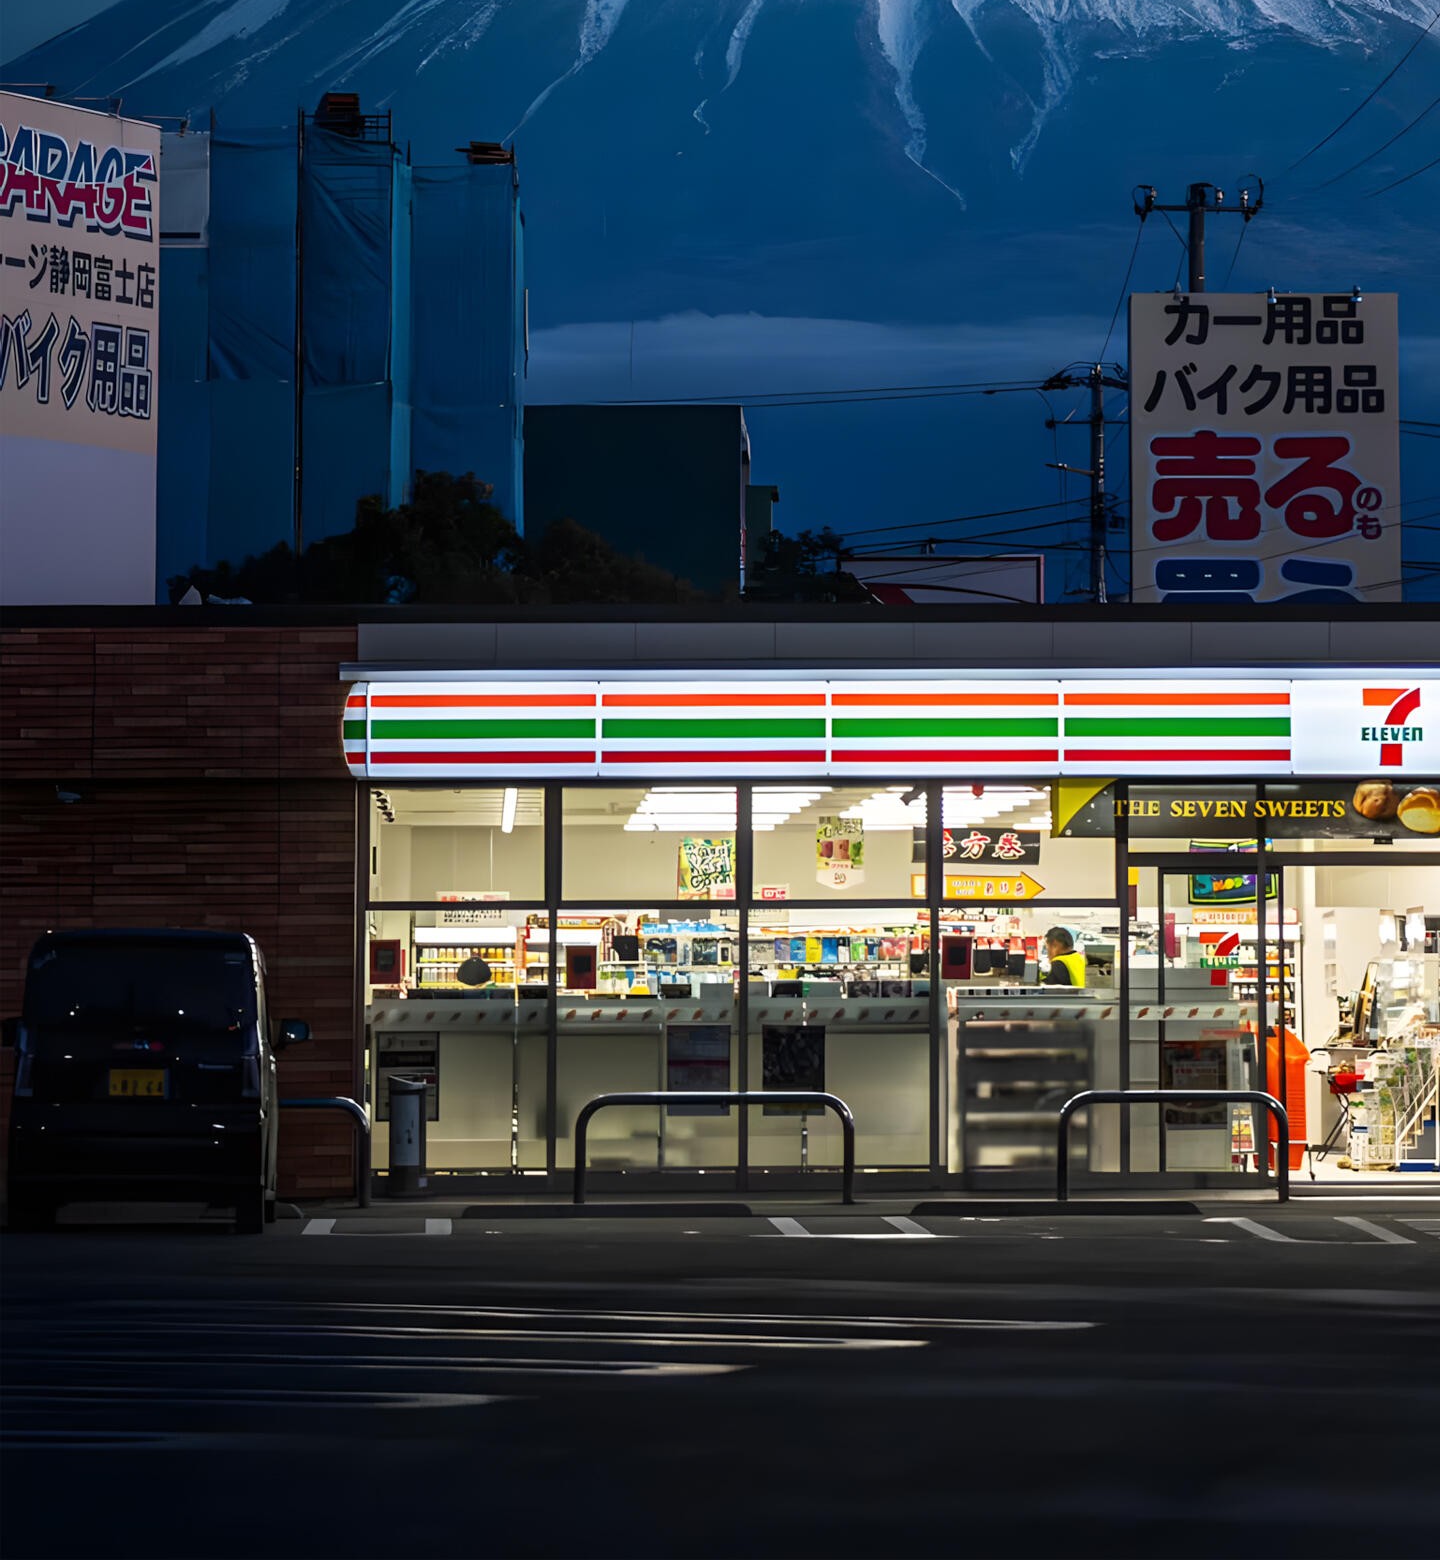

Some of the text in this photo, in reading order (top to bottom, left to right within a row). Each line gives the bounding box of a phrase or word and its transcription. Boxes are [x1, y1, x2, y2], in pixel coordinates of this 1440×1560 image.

[0, 121, 157, 242] ARAGE
[0, 244, 156, 309] ージ静岡富士店
[1164, 295, 1364, 345] カー用品
[0, 309, 152, 419] バイク用品
[1144, 362, 1385, 415] バイク用品
[1149, 430, 1362, 541] 売る
[1362, 687, 1421, 766] 7
[1112, 799, 1346, 818] THE SEVEN SWEETS
